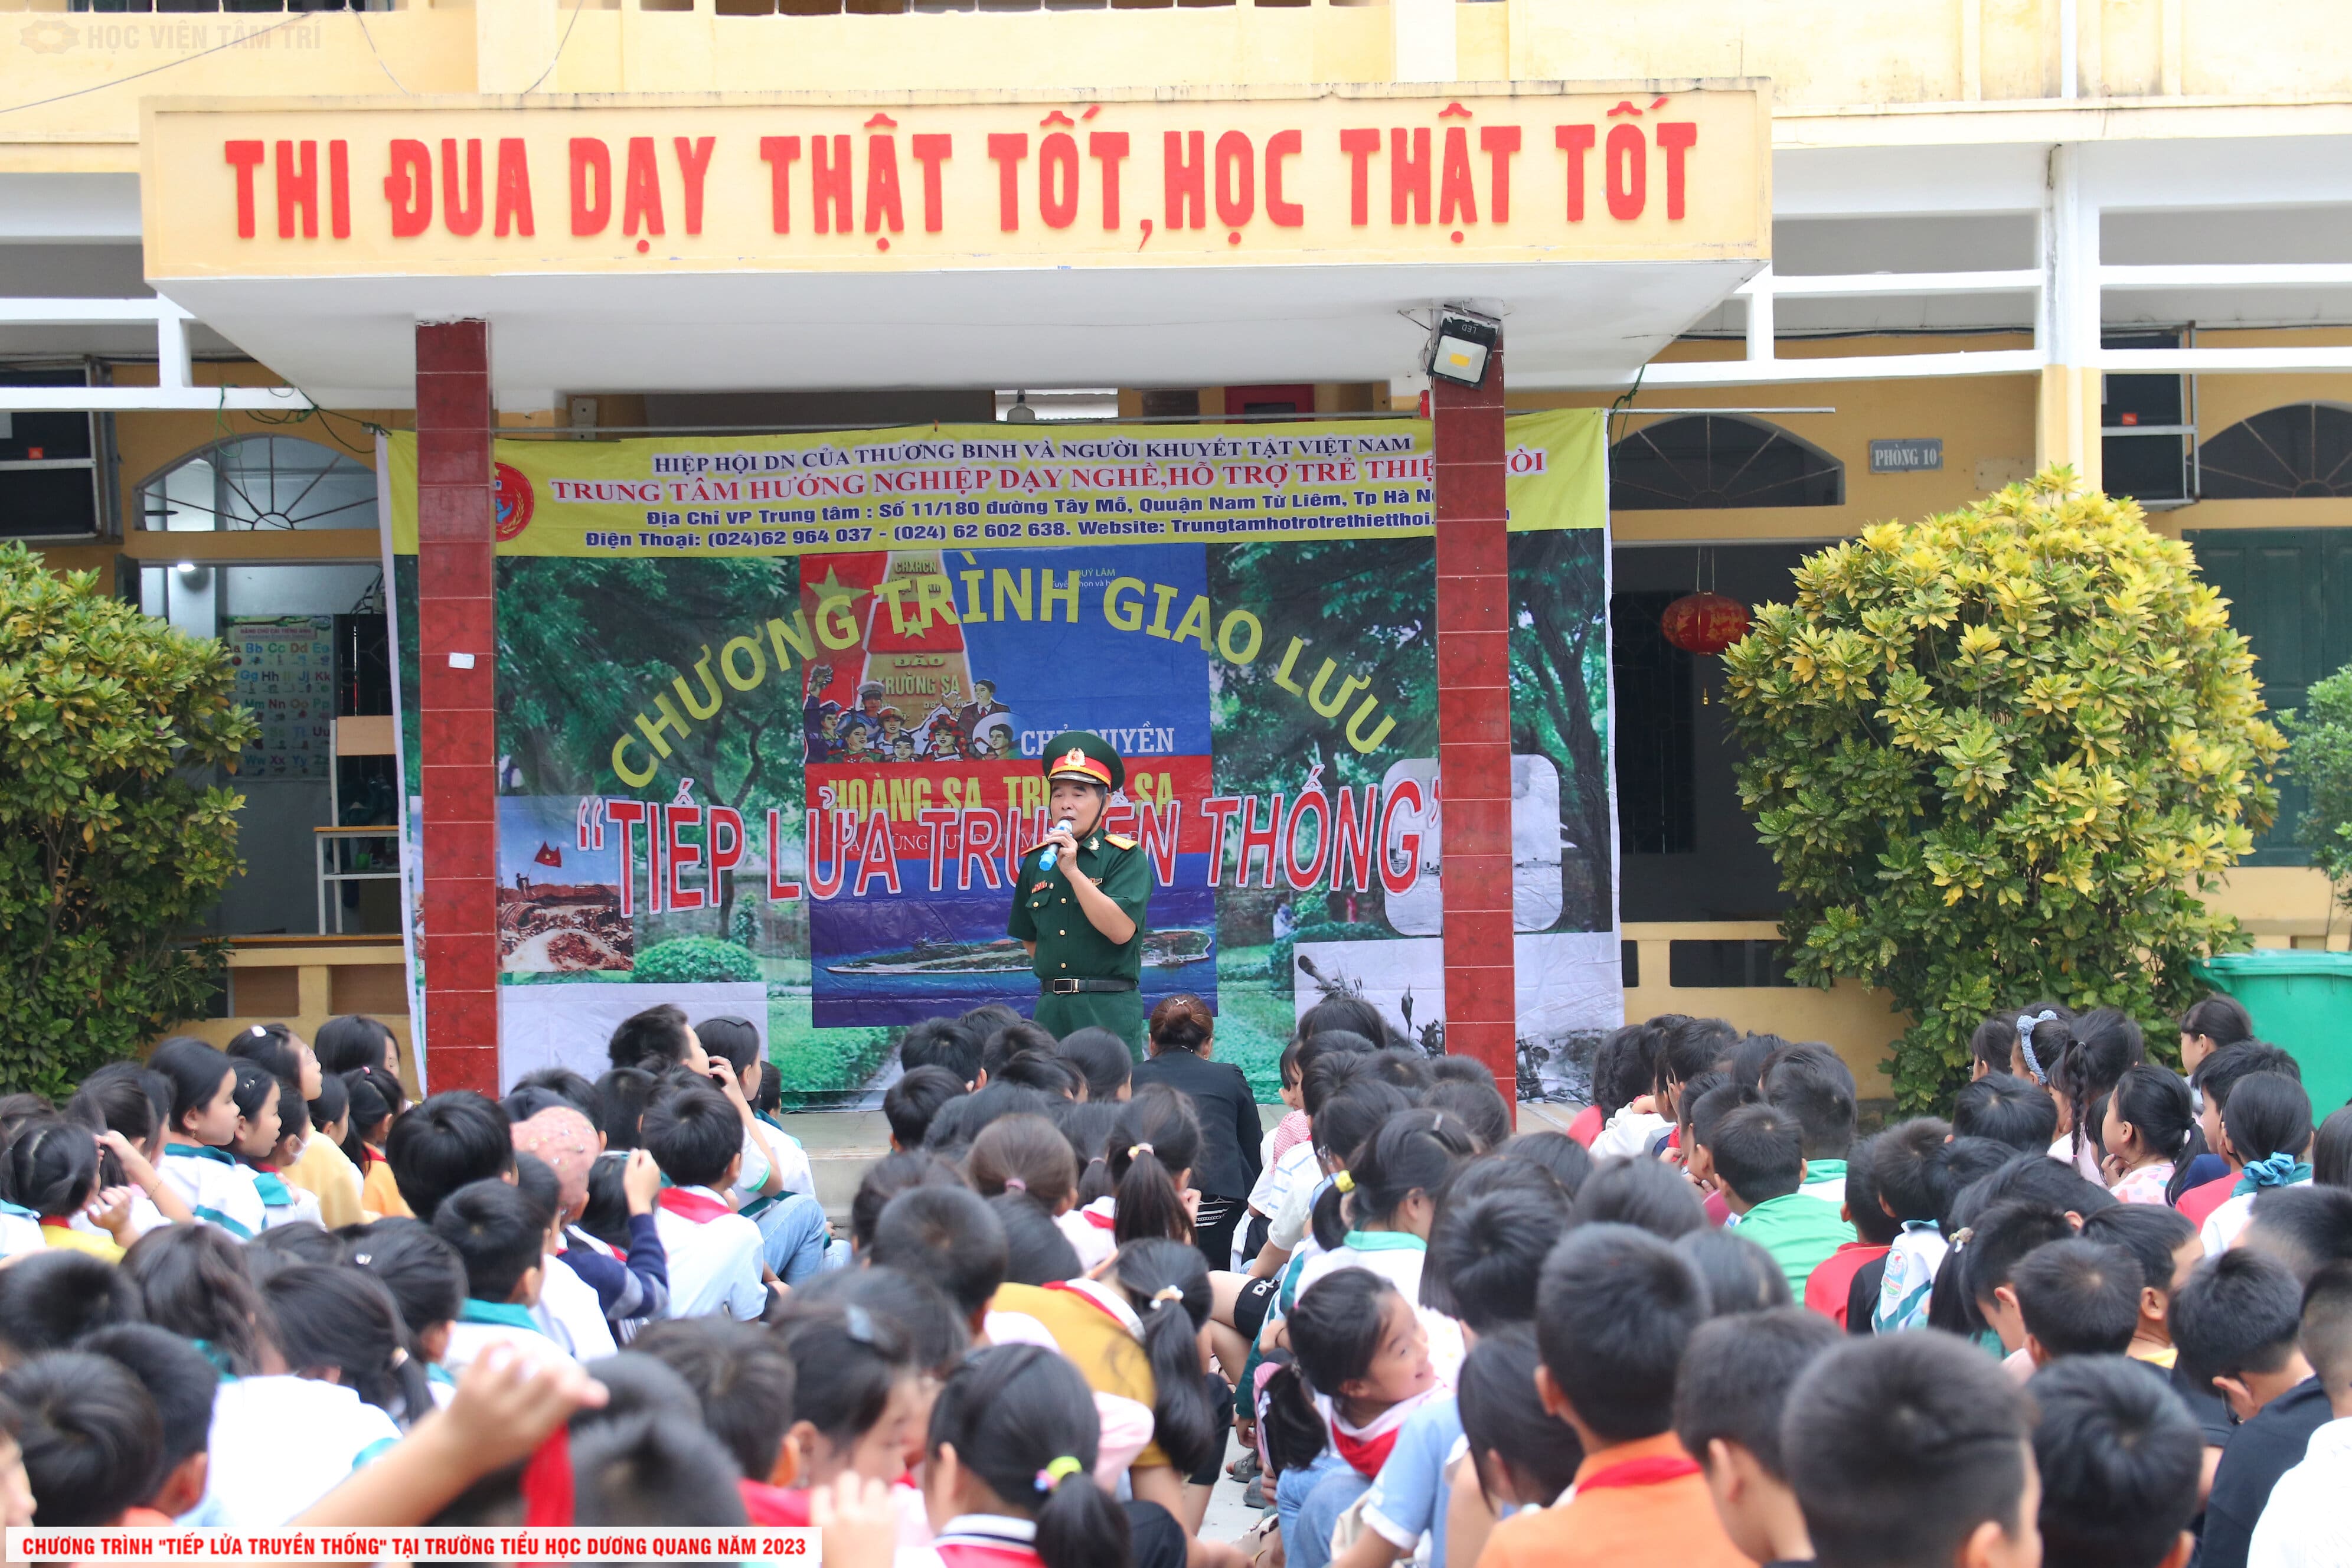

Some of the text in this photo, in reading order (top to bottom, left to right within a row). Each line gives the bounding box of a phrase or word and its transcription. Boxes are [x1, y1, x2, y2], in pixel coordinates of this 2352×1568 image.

[226, 140, 351, 239] THI
[384, 139, 535, 237] ĐUA
[570, 137, 716, 253] DẠY
[760, 114, 952, 251] THẬT
[1341, 103, 1521, 243] THẬT
[1556, 97, 1697, 222] TỐT
[1462, 324, 1476, 334] LED
[655, 437, 1410, 475] HIỆP HỘI DN CỦA THƯƠNG BINH VÀ NGƯỜI KHUYẾT TẬT VIỆT NAM
[1875, 444, 1937, 466] PHÒNG 10
[552, 482, 660, 501] TRUNG
[669, 477, 739, 501] TÂM
[750, 473, 864, 499] HƯỚNG
[874, 468, 992, 495] NGHIỆP
[1000, 469, 1063, 494] DẠY
[1223, 463, 1288, 488] TRỢ
[1296, 458, 1356, 482] TRẺ
[1366, 455, 1433, 482] THIỆ
[647, 512, 680, 527] Địa
[687, 511, 719, 525] Chỉ
[727, 512, 752, 524] VP
[759, 509, 815, 524] Trung
[822, 506, 860, 521] tâm
[880, 501, 904, 517] Số
[912, 502, 979, 517] 11/180
[986, 501, 1048, 515] đường
[1054, 499, 1089, 514] Tây
[1096, 497, 1133, 514] Mỗ,
[1139, 498, 1203, 514] Quuận
[1210, 496, 1255, 510] Nam
[1262, 494, 1286, 508] Từ
[1292, 493, 1347, 508] Liêm,
[1354, 491, 1377, 507] Tp
[1384, 489, 1409, 504] Hà
[586, 533, 632, 549] Điện
[638, 533, 700, 549] Thoại:
[793, 530, 829, 544] 964
[836, 528, 873, 542] 037
[894, 525, 946, 541] (024)
[953, 525, 978, 538] 62
[985, 524, 1021, 537] 602
[1028, 522, 1072, 537] 638.
[1078, 520, 1164, 535] Website:
[246, 643, 263, 652] Bb
[268, 643, 286, 653] Cc
[290, 643, 308, 652] Dd
[262, 671, 279, 681] Hh
[316, 671, 331, 681] Kk
[612, 551, 1397, 789] CHƯƠNG TRÌNH GIAO LƯU
[941, 675, 961, 694] SA
[269, 699, 286, 709] Nn
[828, 772, 932, 824] HOÀNG
[942, 777, 984, 812] SA
[1134, 772, 1174, 816] SA
[766, 785, 902, 902] LỬA
